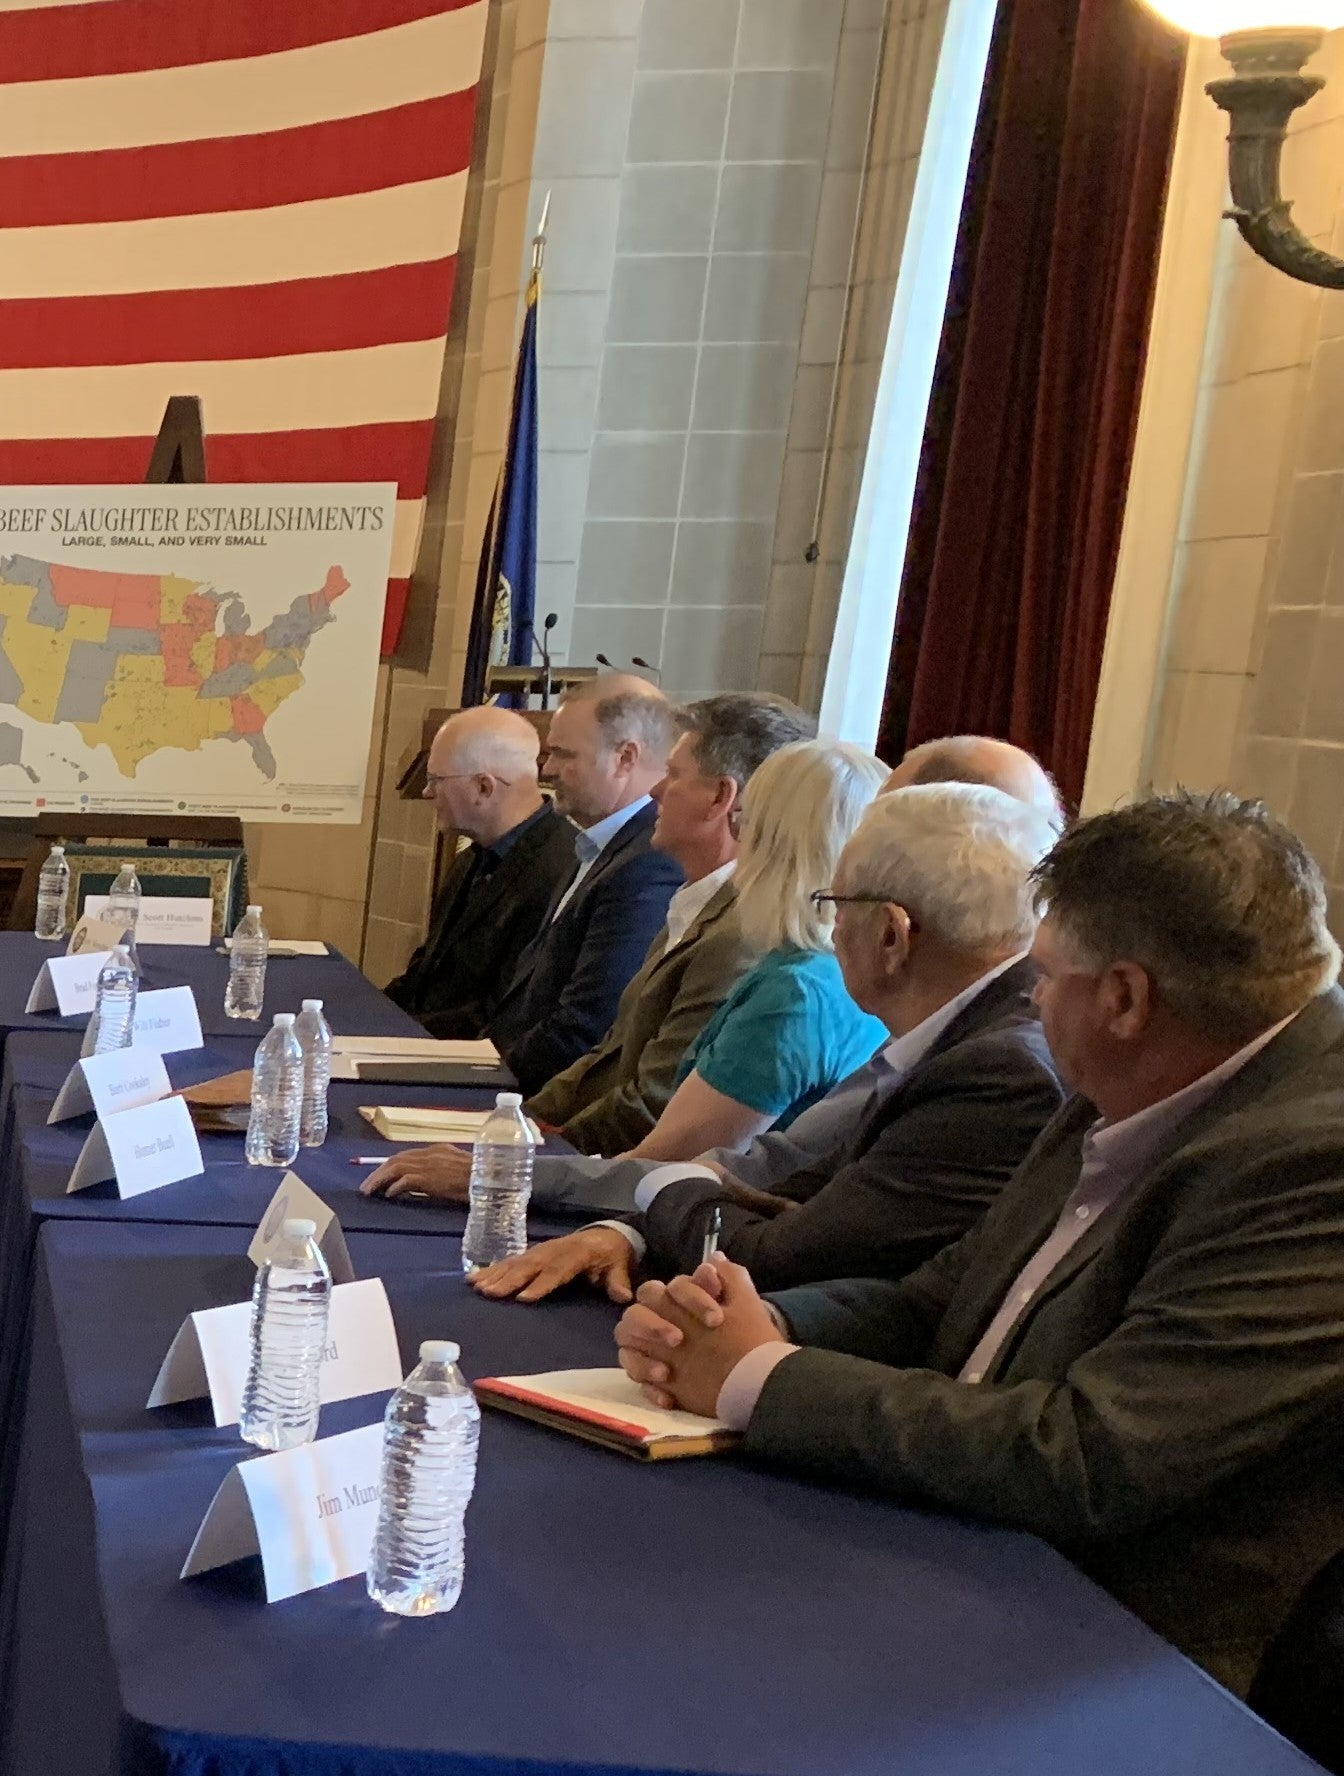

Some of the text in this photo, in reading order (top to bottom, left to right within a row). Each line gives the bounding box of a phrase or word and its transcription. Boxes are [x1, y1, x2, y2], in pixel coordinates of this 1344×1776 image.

[50, 507, 179, 532] SLAUGHTER
[185, 506, 384, 531] ESTABLISHMENTS
[62, 535, 268, 548] LARGE, SMALL, AND VERY SMALL
[316, 1493, 343, 1519] Jim
